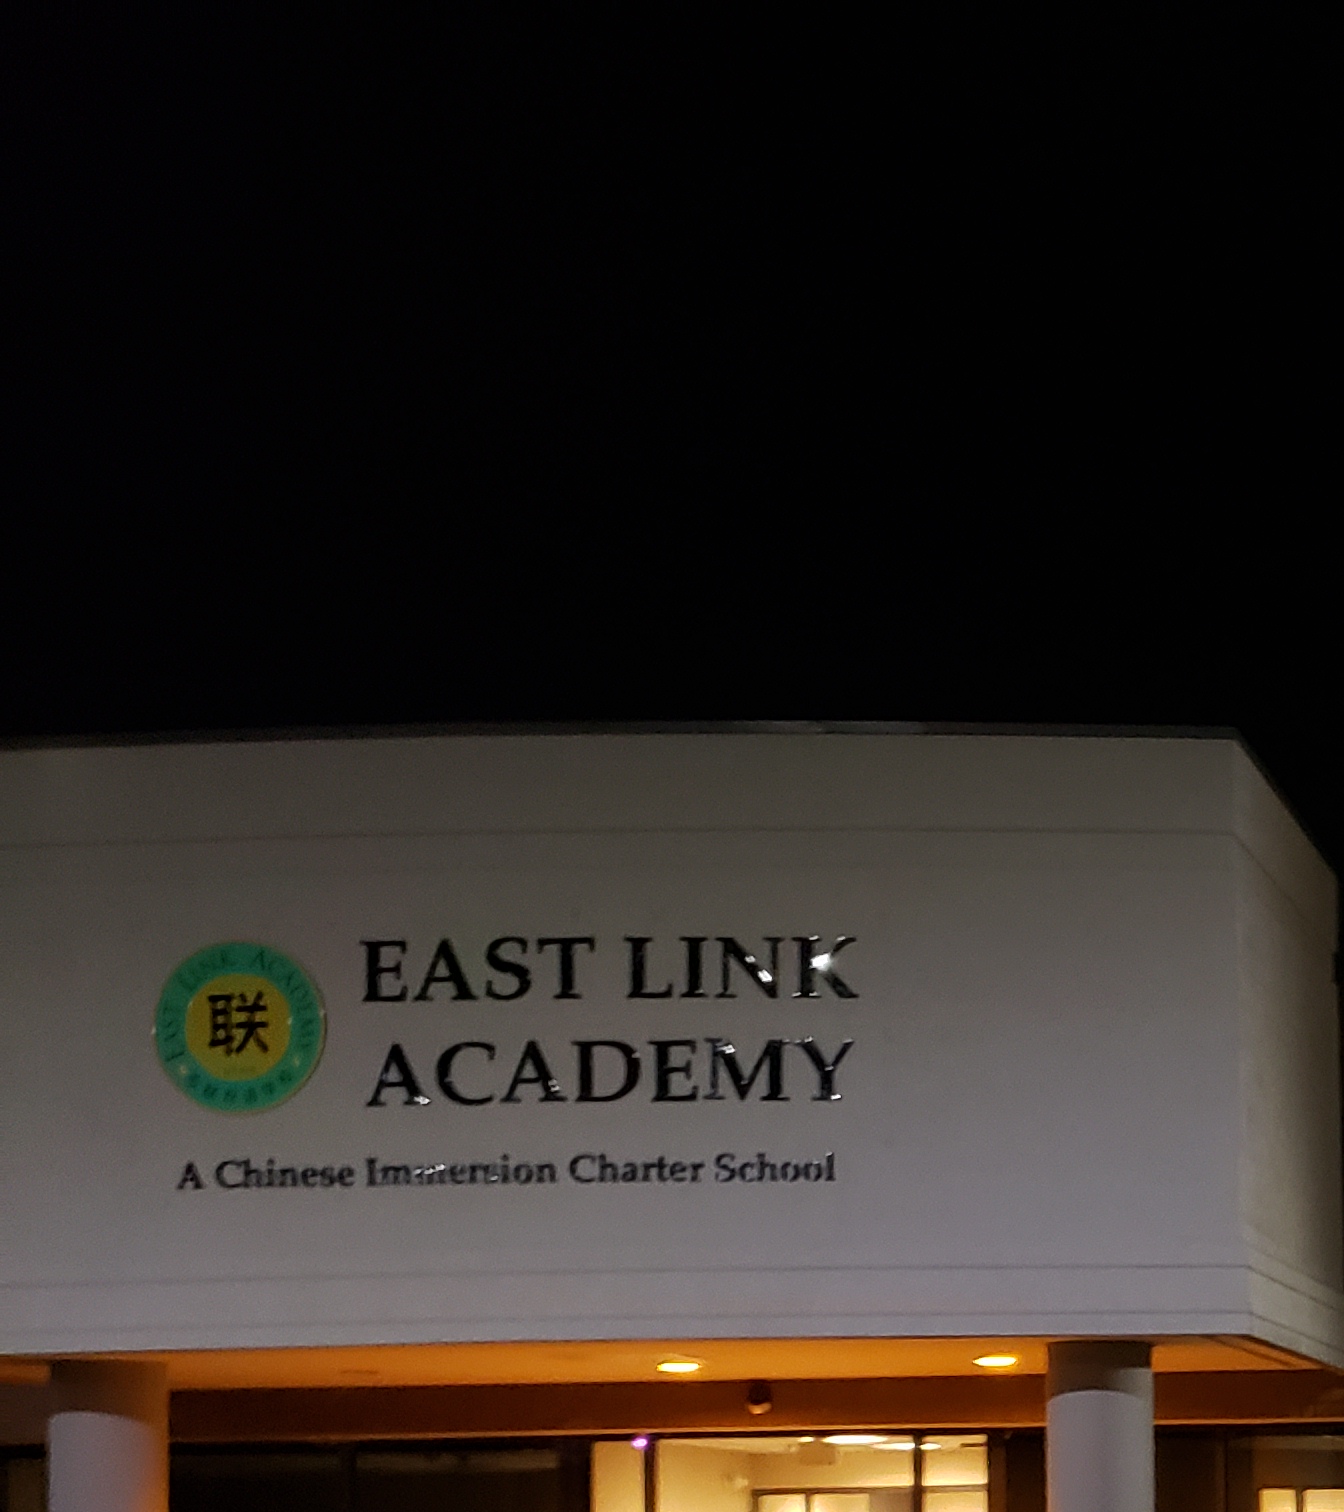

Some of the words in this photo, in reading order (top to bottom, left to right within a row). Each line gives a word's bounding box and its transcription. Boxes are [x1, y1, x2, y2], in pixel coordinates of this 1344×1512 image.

[361, 936, 595, 1003] EAST
[623, 935, 859, 999] LINK
[207, 990, 270, 1057] 联
[365, 1037, 854, 1107] ACADEMY
[177, 1160, 204, 1190] A
[214, 1157, 355, 1189] Chinese
[365, 1154, 558, 1187] Immersion
[568, 1153, 705, 1184] Charter
[714, 1151, 837, 1183] School
